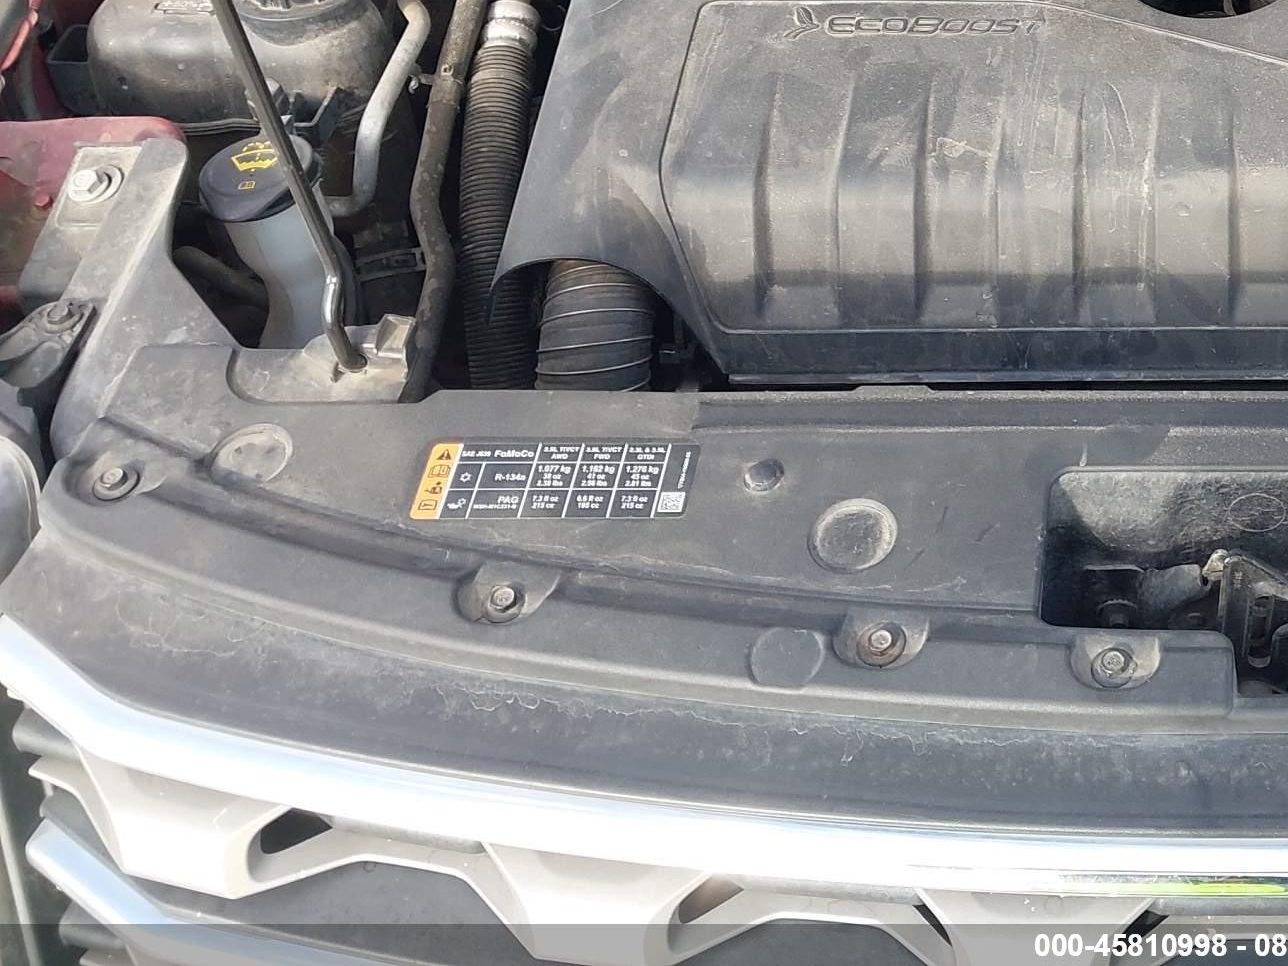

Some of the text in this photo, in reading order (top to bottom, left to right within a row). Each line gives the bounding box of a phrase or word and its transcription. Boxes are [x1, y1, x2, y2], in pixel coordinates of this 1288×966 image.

[494, 449, 535, 458] FoMoCo
[538, 465, 572, 474] 1.077 kg
[604, 465, 616, 474] kg
[648, 465, 660, 474] kg
[494, 473, 526, 481] R-134a
[497, 495, 519, 504] PAG
